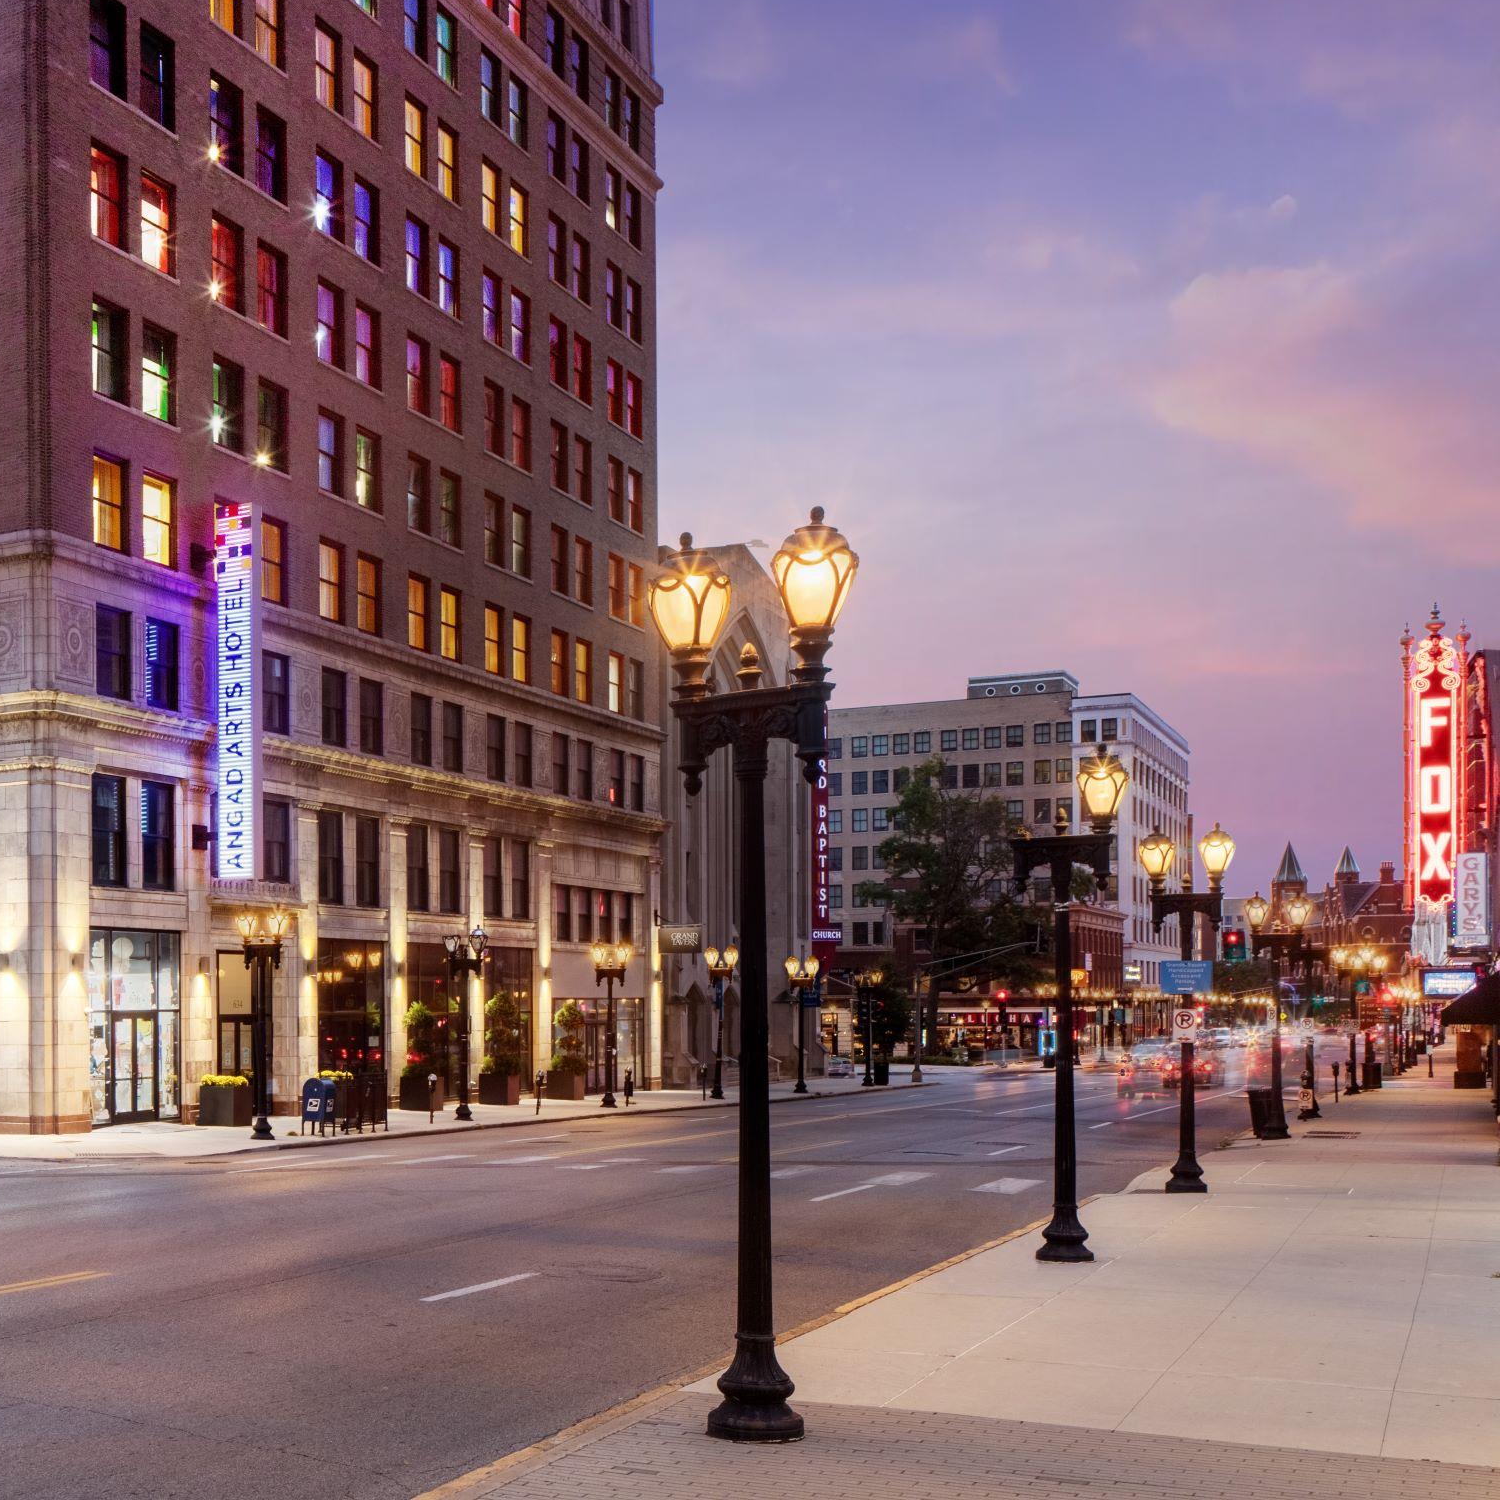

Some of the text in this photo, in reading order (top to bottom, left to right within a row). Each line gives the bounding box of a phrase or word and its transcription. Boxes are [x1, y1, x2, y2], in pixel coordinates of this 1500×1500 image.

[224, 578, 244, 869] ANGAD ARTS HOTEL
[1419, 696, 1452, 881] FOX
[817, 804, 828, 918] BAPTIST
[1462, 856, 1483, 931] GARY'S
[670, 932, 699, 940] GRAND
[671, 939, 698, 947] TAVERN
[812, 930, 842, 940] CHURCH
